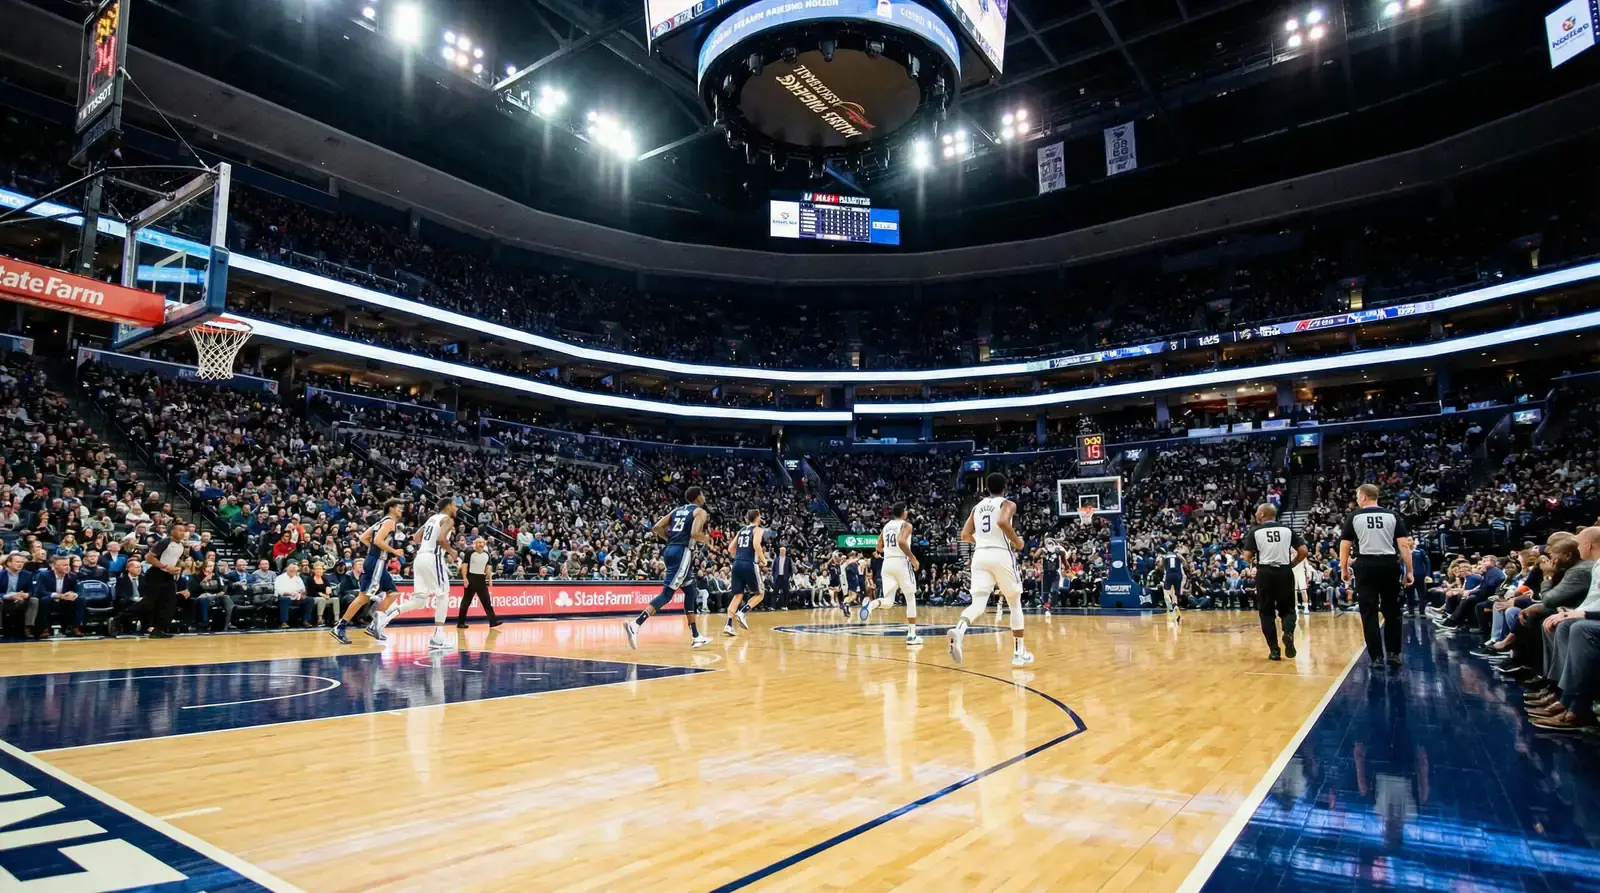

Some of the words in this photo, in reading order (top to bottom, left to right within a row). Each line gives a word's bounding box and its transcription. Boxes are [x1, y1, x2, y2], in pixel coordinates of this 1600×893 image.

[87, 83, 113, 115] TISSOT
[982, 515, 991, 533] 3
[1367, 516, 1384, 529] 95
